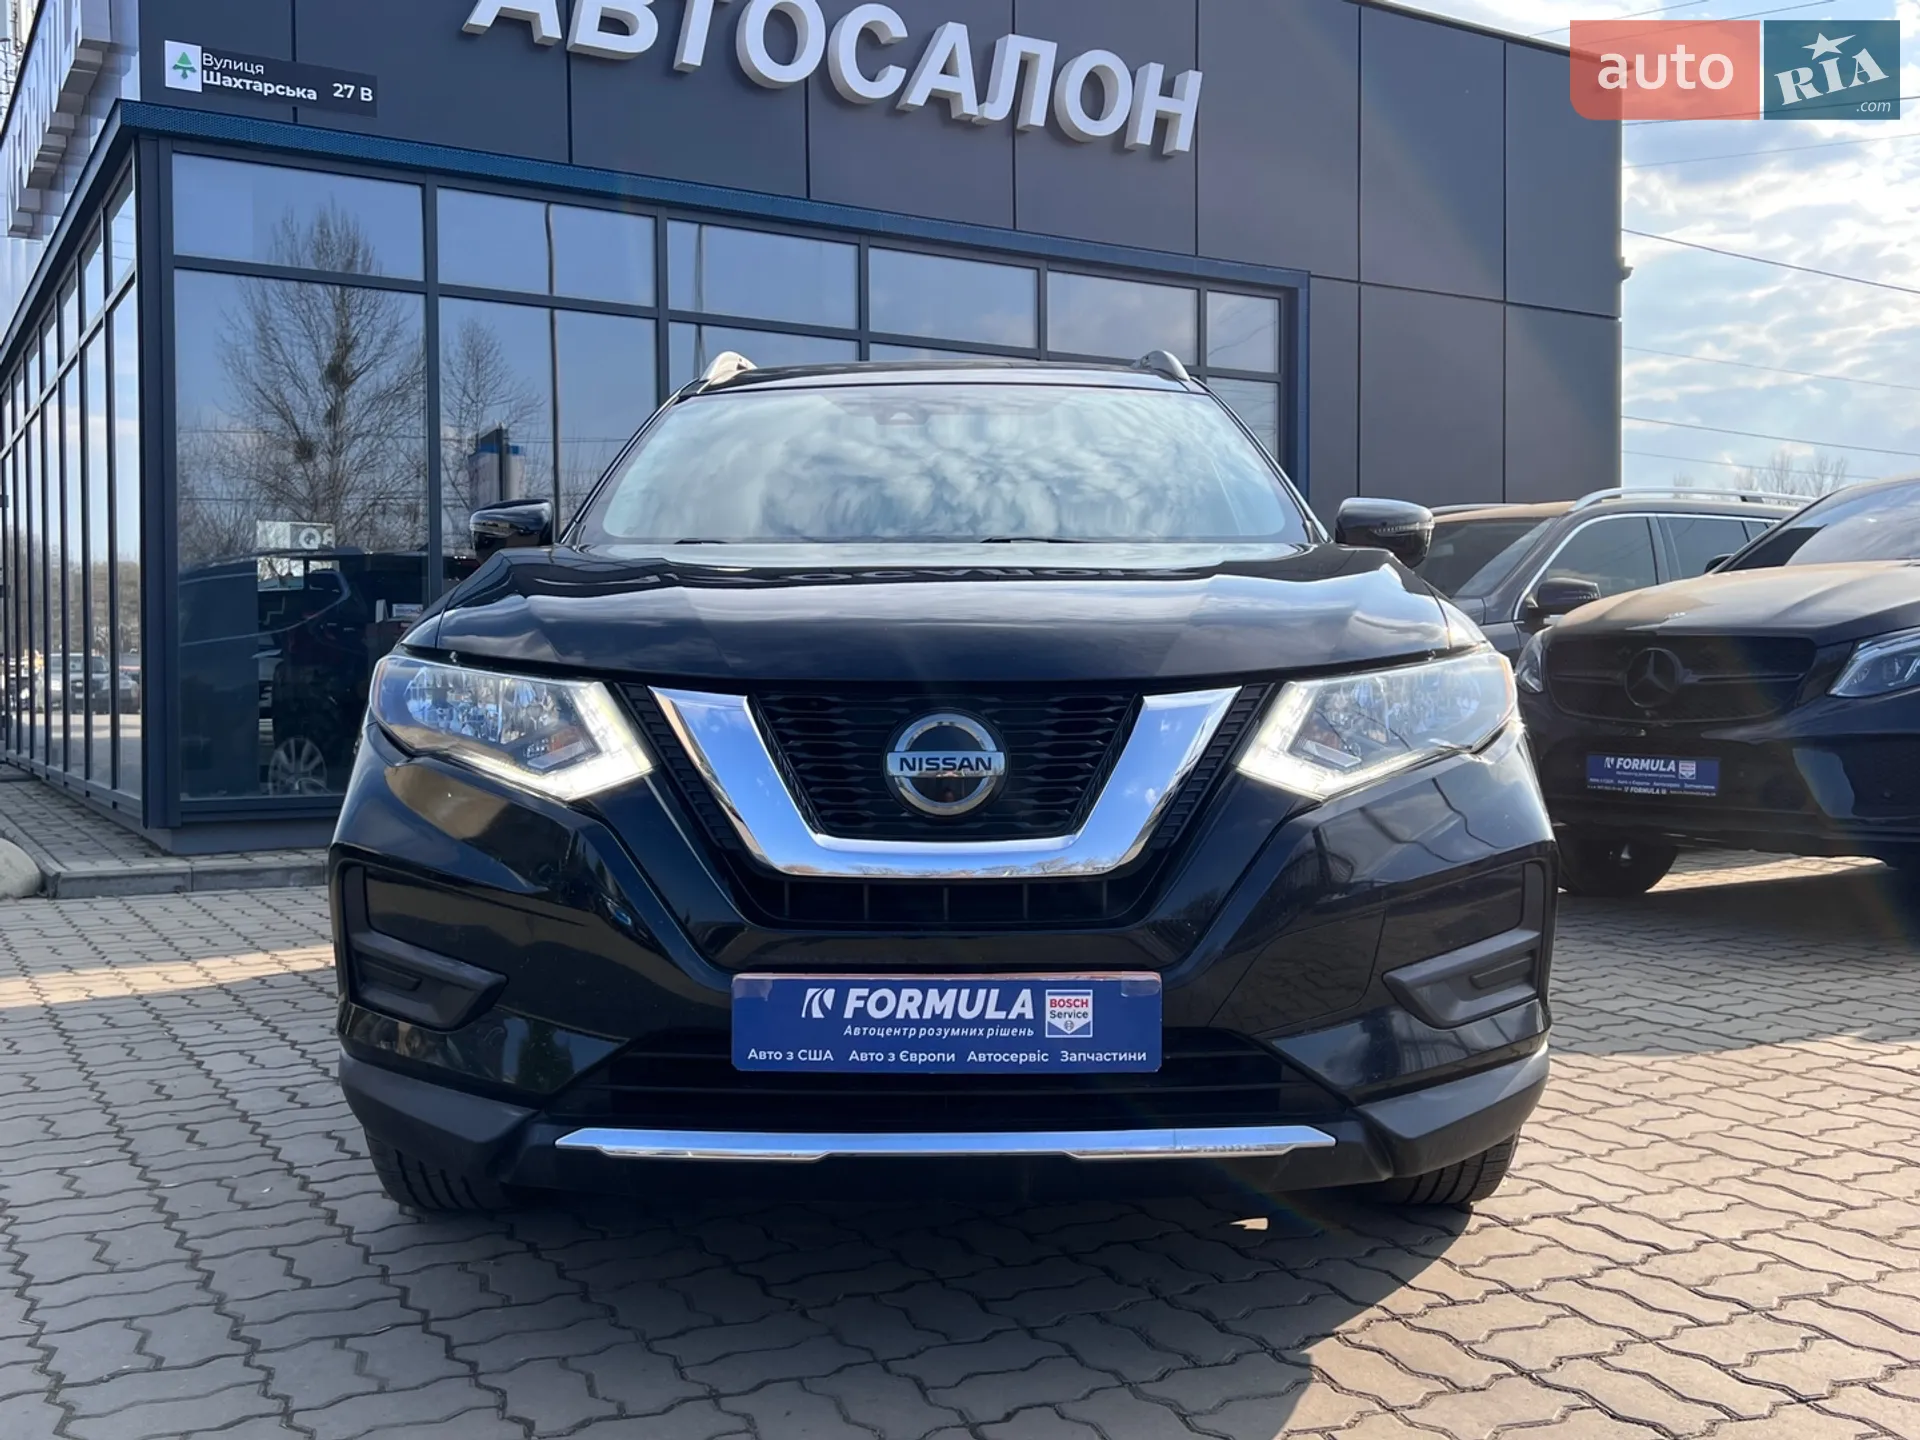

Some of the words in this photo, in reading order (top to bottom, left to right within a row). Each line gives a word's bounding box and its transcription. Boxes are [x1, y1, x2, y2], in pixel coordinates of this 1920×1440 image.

[202, 53, 265, 75] Вулиця
[202, 70, 317, 100] Шахтарська
[332, 83, 354, 98] 27
[360, 87, 373, 101] В
[900, 757, 992, 771] NISSAN
[1616, 757, 1676, 772] FORMULA
[843, 988, 1034, 1019] FORMULA
[1050, 999, 1088, 1008] BOSCH
[1050, 1010, 1088, 1019] Service
[843, 1025, 916, 1039] Автоцентр
[919, 1027, 984, 1039] розумних
[986, 1025, 1034, 1039] рішень
[748, 1048, 783, 1060] Авто
[786, 1050, 794, 1060] з
[798, 1050, 834, 1061] США
[849, 1050, 884, 1062] Авто
[888, 1052, 896, 1062] з
[900, 1051, 955, 1064] Європи
[967, 1050, 1049, 1064] Автосервіс
[1060, 1051, 1147, 1062] Запчастини
